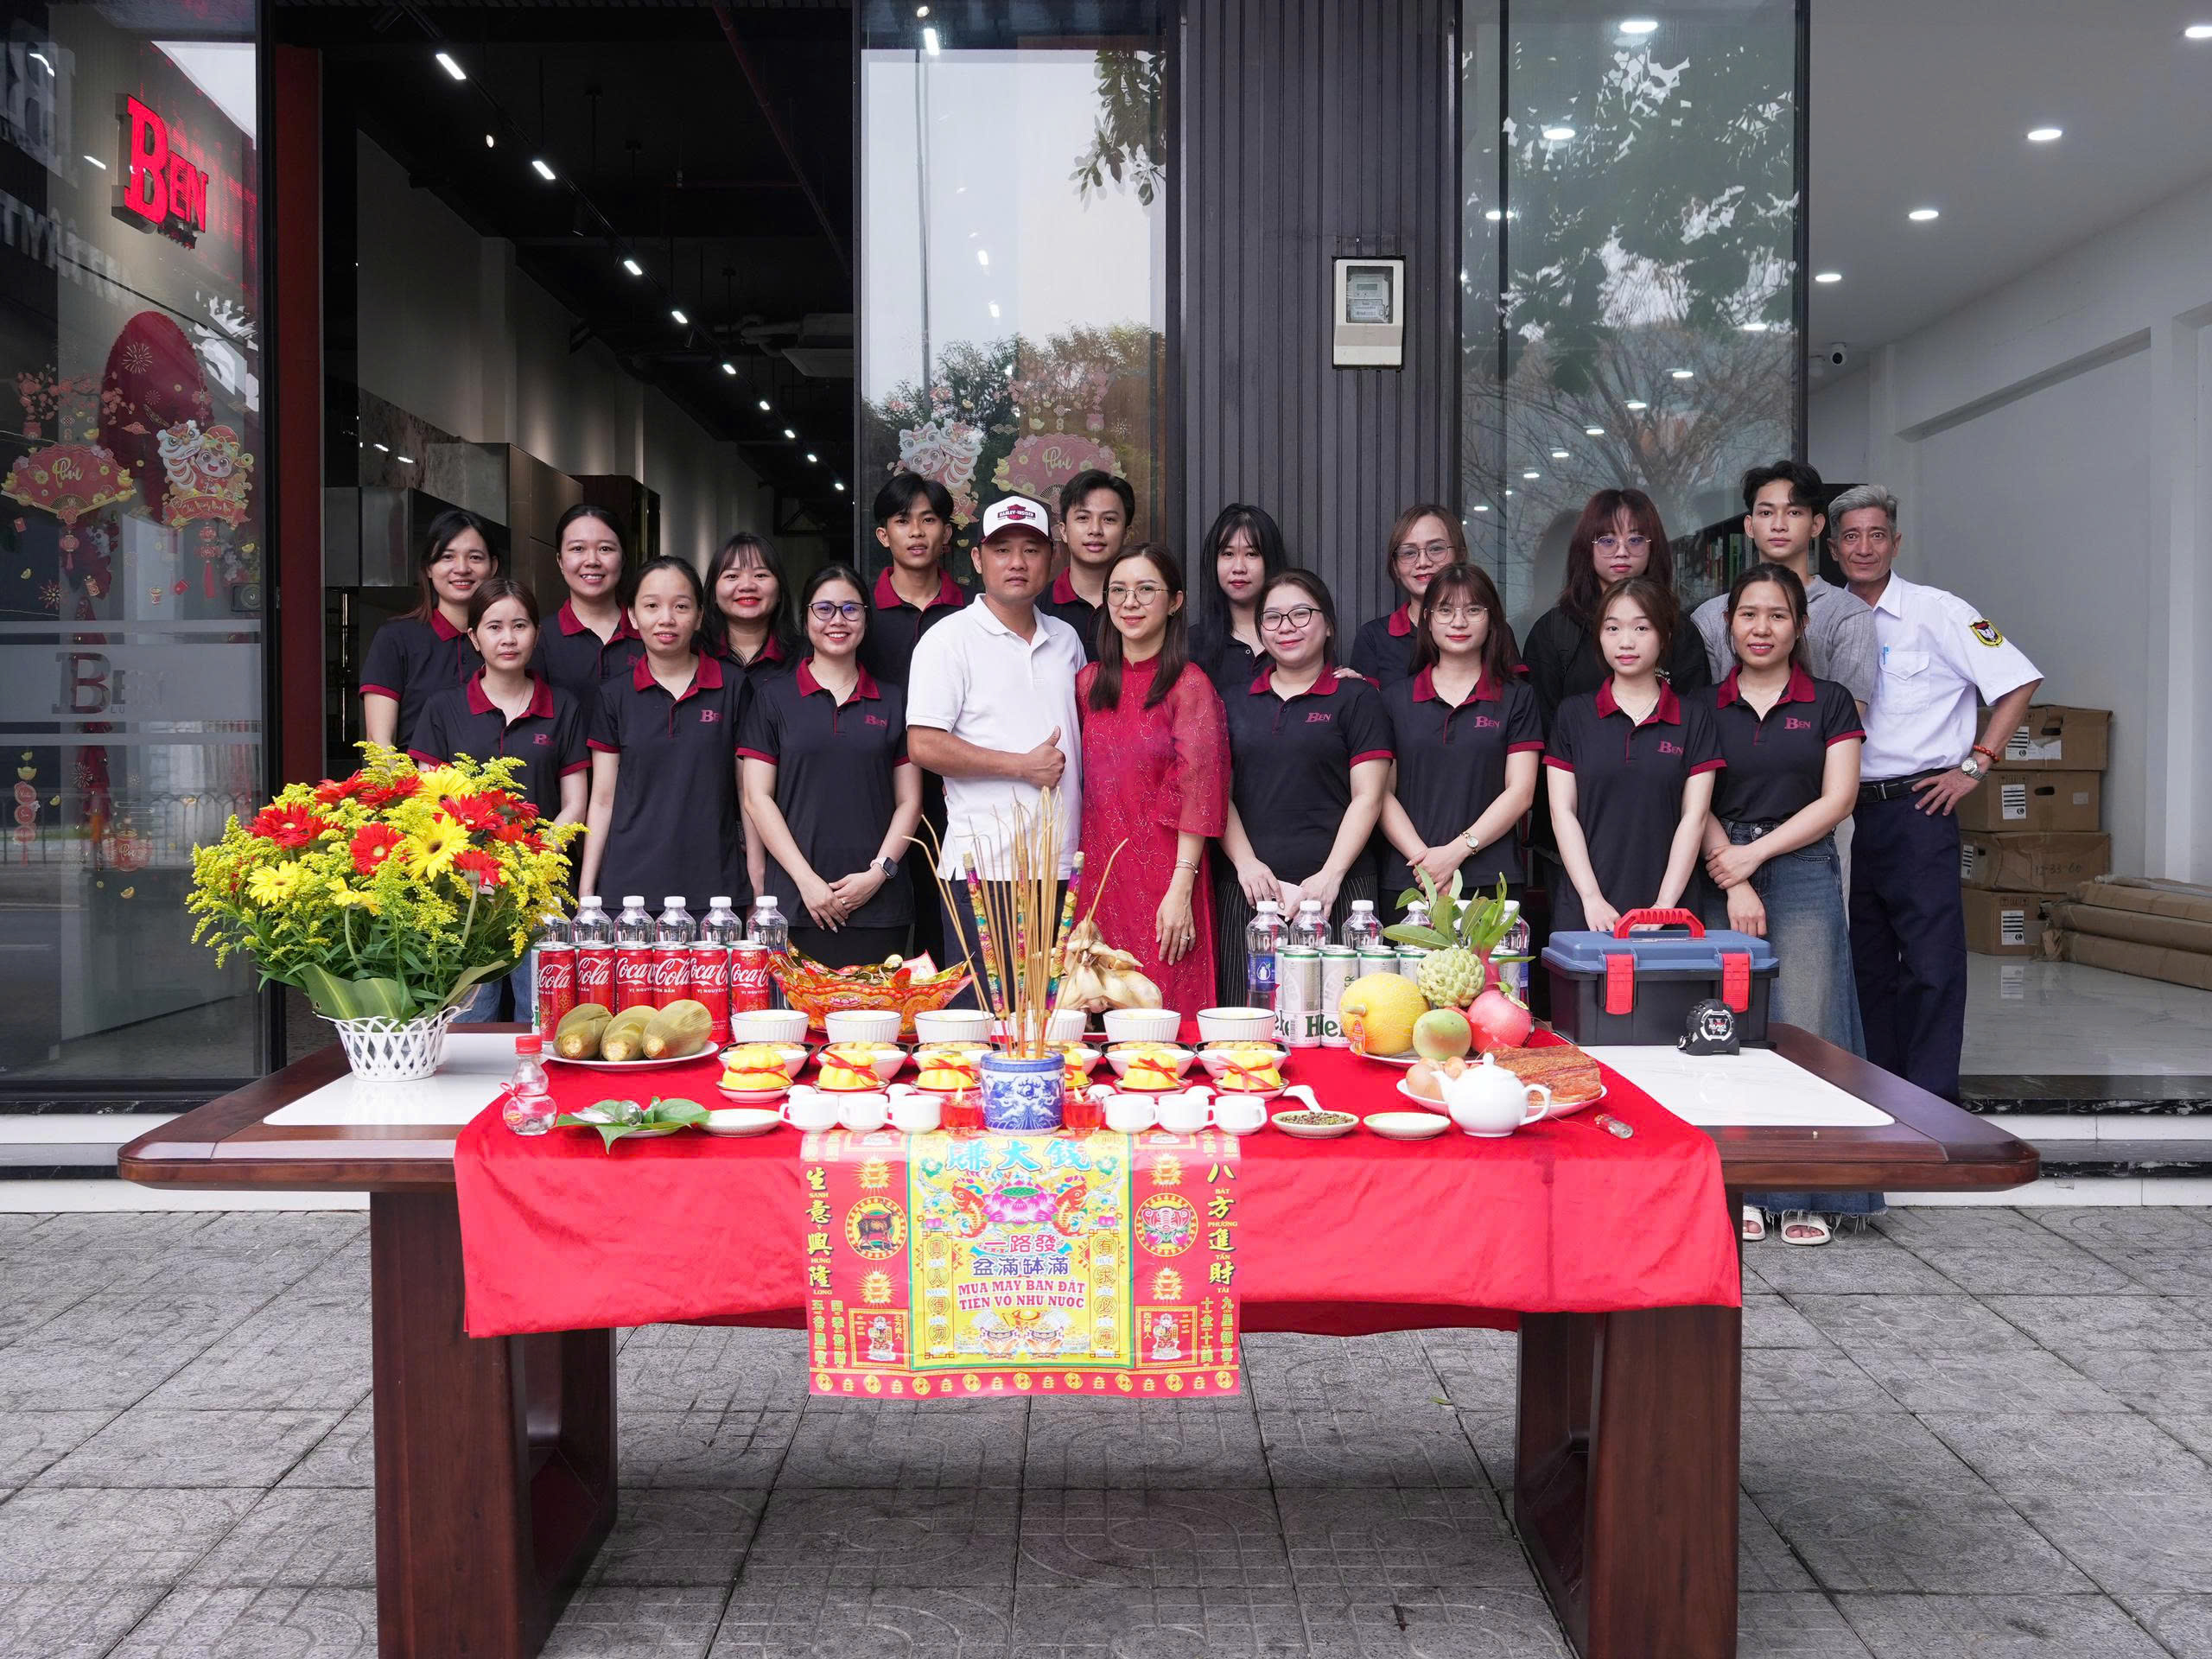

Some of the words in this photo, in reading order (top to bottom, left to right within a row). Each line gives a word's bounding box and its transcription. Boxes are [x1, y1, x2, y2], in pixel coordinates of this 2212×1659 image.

[124, 94, 209, 233] BEN
[1305, 712, 1332, 723] BEN
[1474, 715, 1501, 728] BEN
[1784, 717, 1811, 729] BEN
[1657, 741, 1684, 754] BEN
[945, 1140, 1092, 1172] 賺大錢
[984, 1234, 1057, 1253] 一路發
[957, 1282, 988, 1295] MUA
[992, 1281, 1021, 1293] MAY
